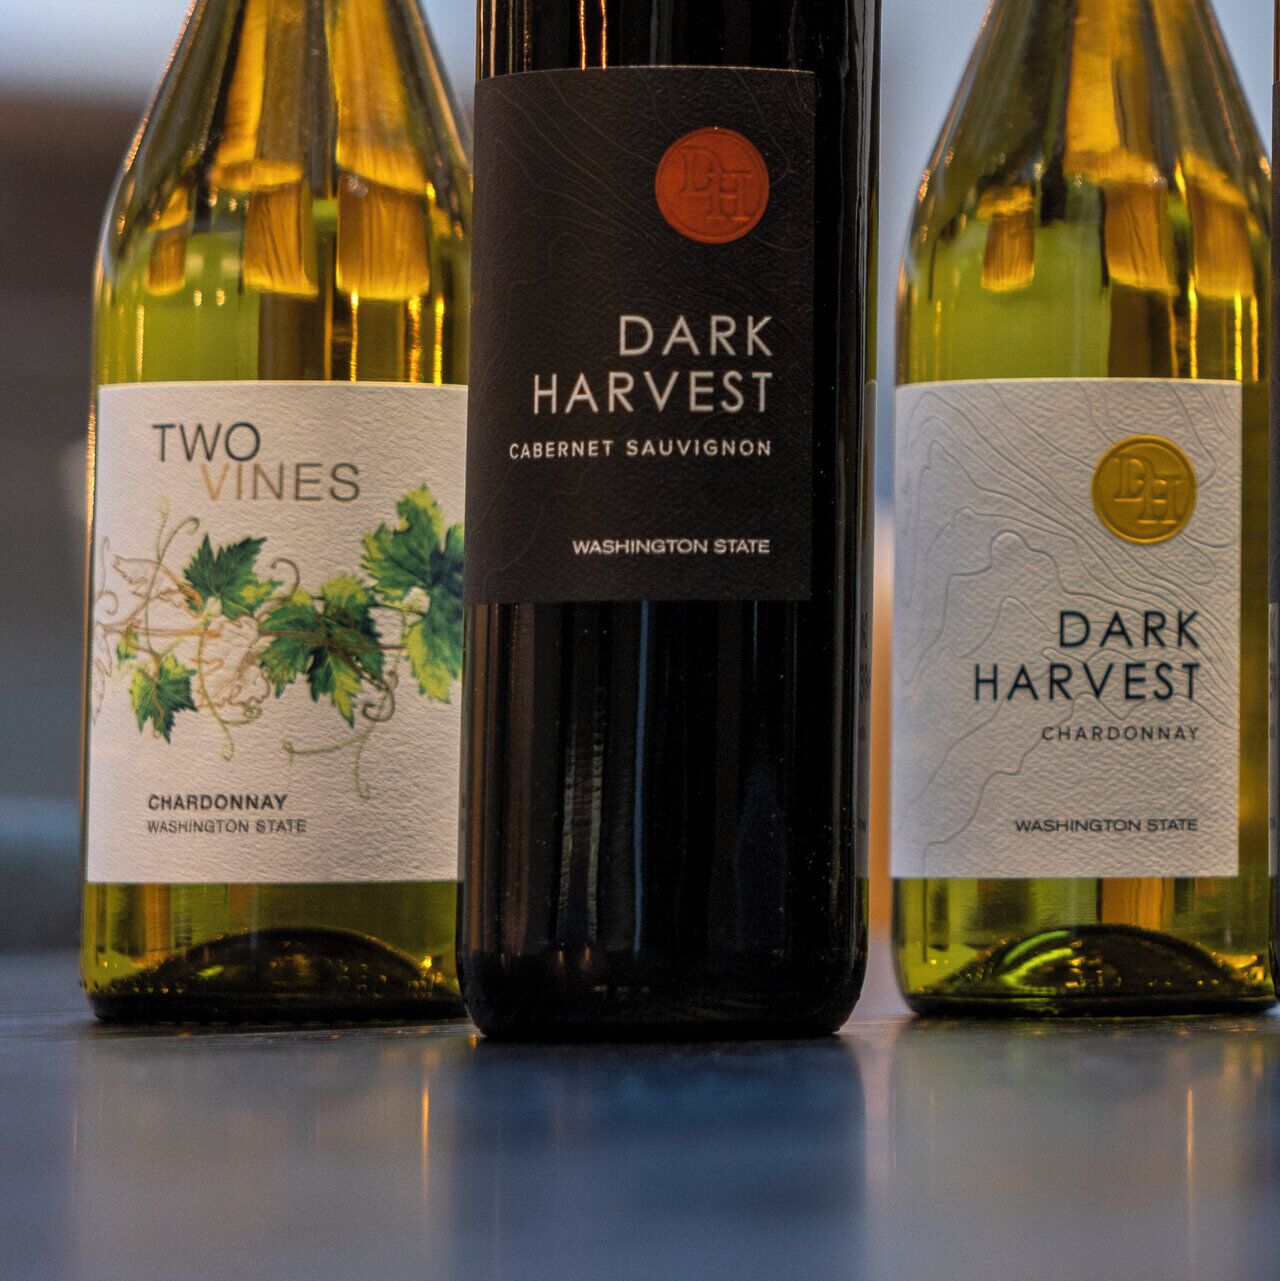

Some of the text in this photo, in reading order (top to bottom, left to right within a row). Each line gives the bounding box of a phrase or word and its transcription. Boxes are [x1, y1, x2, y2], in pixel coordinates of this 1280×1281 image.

[619, 315, 771, 356] DARK
[534, 371, 772, 414] HARVEST
[153, 422, 261, 462] TWO
[510, 439, 770, 459] CABERNET SAUVIGNON
[203, 463, 361, 502] VINES
[573, 539, 769, 554] WASHINGTON STATE
[1059, 610, 1198, 648] DARK
[975, 662, 1200, 701] HARVEST
[1042, 726, 1198, 741] CHARDONNAY
[149, 794, 287, 810] CHARDONNAY
[148, 819, 306, 833] WASHINGTON STATE
[1015, 818, 1197, 832] WASHINGTON STATE
